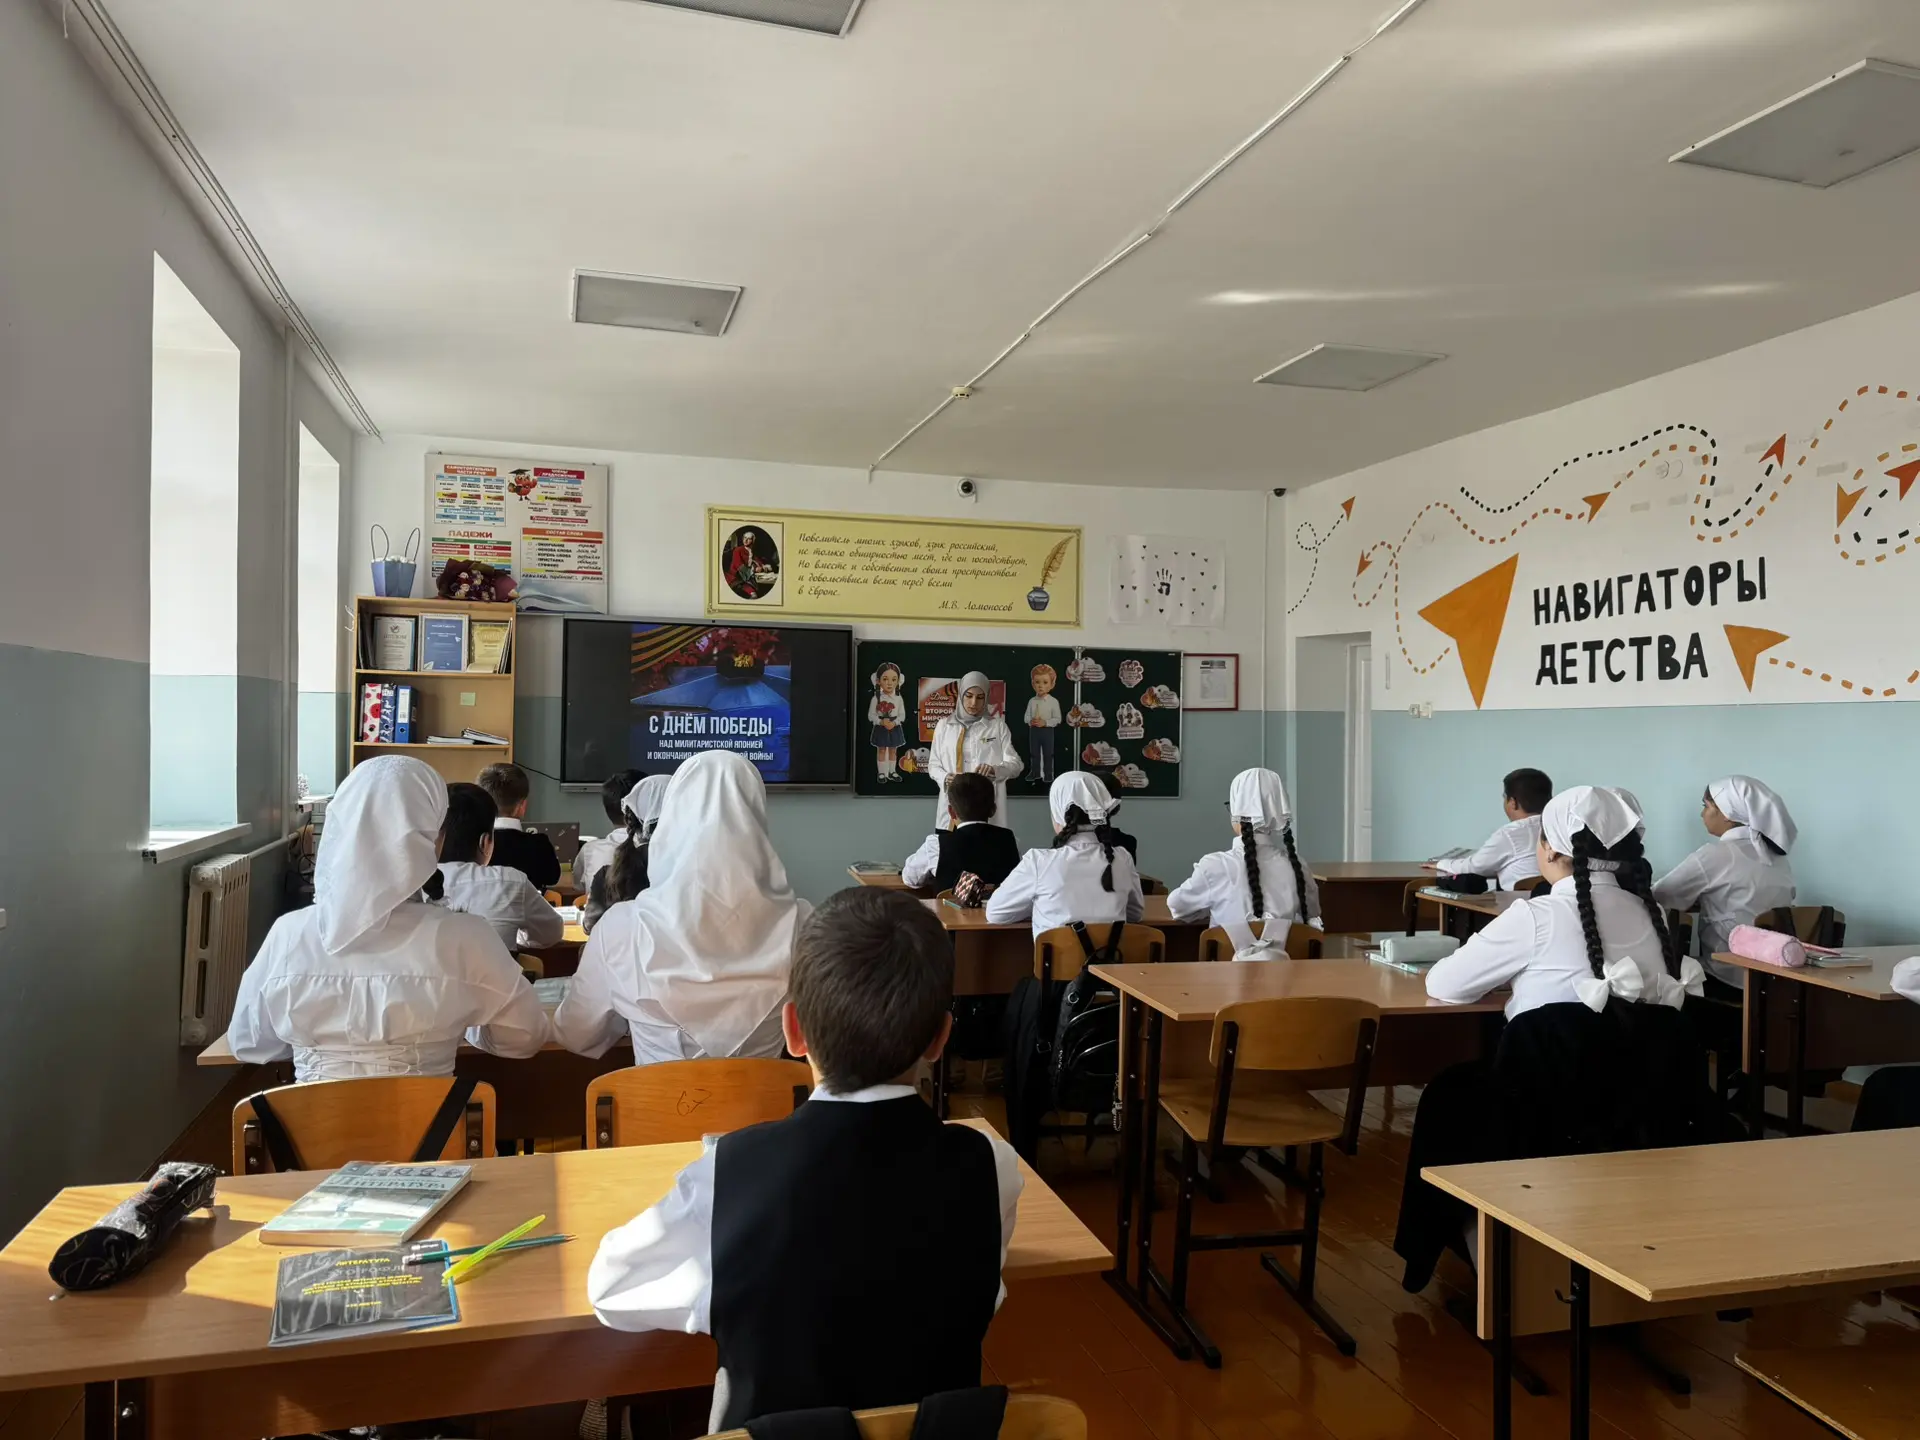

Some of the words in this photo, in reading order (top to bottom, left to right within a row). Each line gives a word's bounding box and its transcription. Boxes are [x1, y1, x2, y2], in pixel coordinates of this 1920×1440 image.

[448, 530, 493, 538] ПАДЕЖИ
[799, 533, 850, 544] Повелитель
[854, 538, 886, 546] многих
[890, 538, 921, 549] языков,
[926, 541, 946, 551] язык
[949, 542, 998, 553] российский,
[813, 549, 845, 557] только
[849, 546, 908, 561] обширностью
[912, 553, 936, 563] мест,
[941, 553, 952, 562] где
[972, 555, 1028, 568] господствует,
[815, 560, 847, 570] вместе
[862, 561, 918, 573] собственным
[922, 565, 948, 574] своим
[952, 567, 1017, 579] пространством
[798, 574, 804, 582] и
[809, 573, 868, 584] довольствием
[873, 575, 898, 585] велик
[902, 577, 924, 590] перед
[928, 578, 953, 588] всеми
[798, 585, 803, 595] в
[1533, 556, 1767, 626] НАВИГАТОРЫ
[964, 601, 1013, 611] Ломоносов
[1535, 632, 1708, 685] ДЕТСТВА
[649, 715, 659, 733] С
[662, 713, 706, 735] ДНЁМ
[710, 716, 772, 736] ПОБЕДЫ
[659, 739, 674, 748] НАД
[675, 739, 733, 749] МИЛИТАРИСТСКОЙ
[734, 739, 763, 749] ЯПОНИЕЙ
[647, 752, 652, 760] И
[653, 751, 692, 760] ОКОНЧАНИЯ
[749, 752, 774, 761] ВОЙНЫ!
[335, 1257, 390, 1266] ЛИТЕРАТУРА
